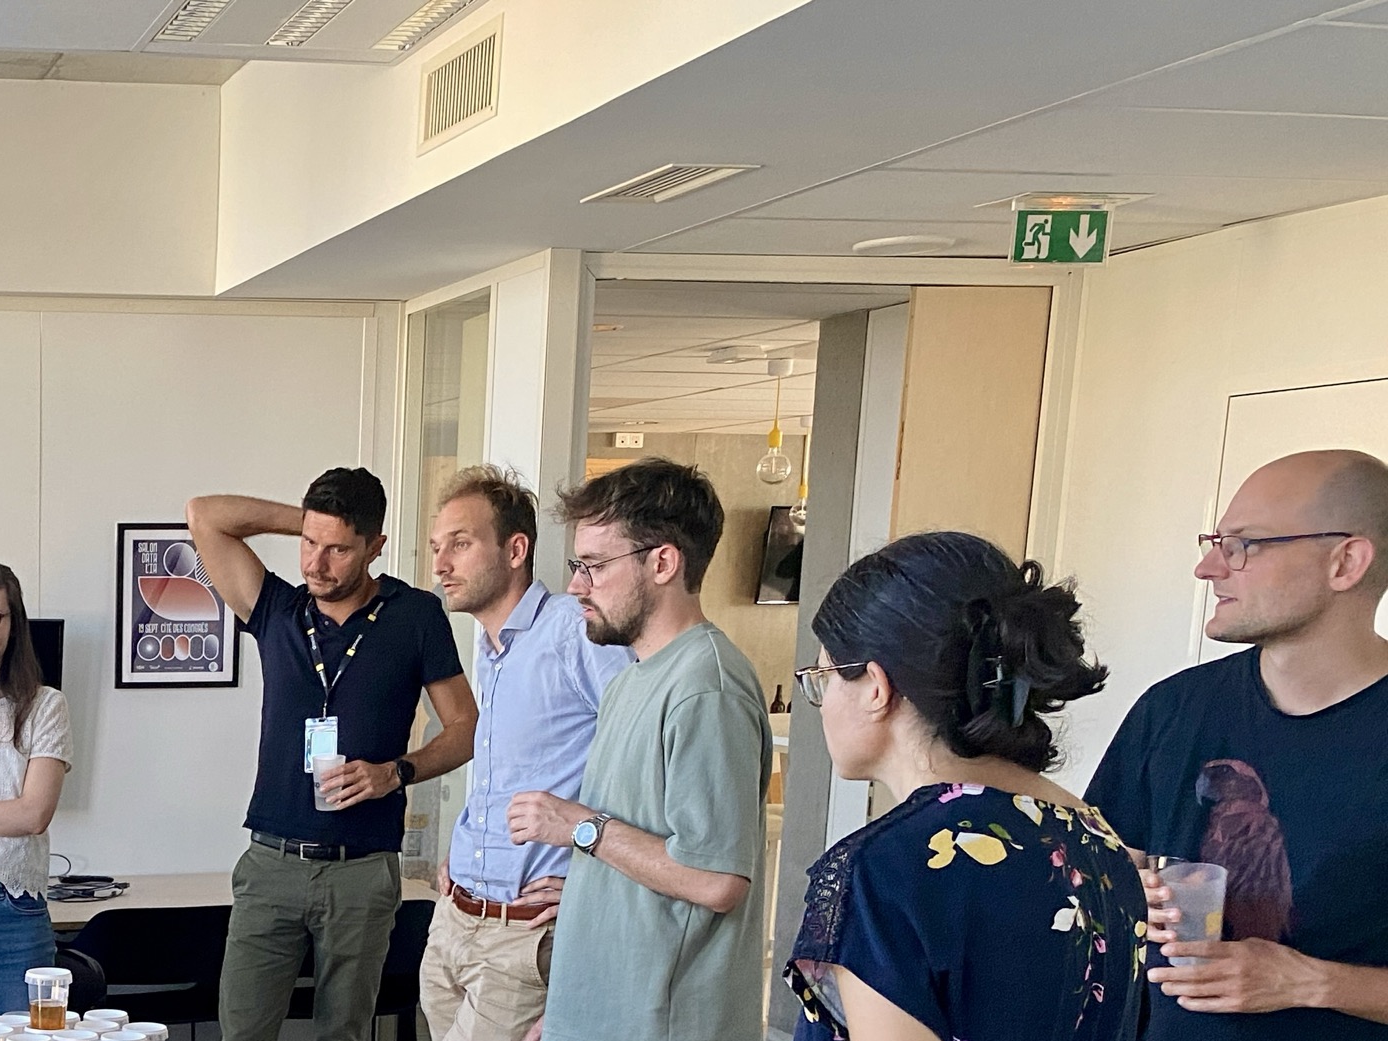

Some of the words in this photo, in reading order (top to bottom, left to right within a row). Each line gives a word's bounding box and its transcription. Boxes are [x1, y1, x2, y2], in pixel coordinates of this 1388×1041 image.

[138, 542, 158, 553] SALON
[141, 553, 158, 563] DATA
[145, 623, 158, 634] SEPT
[173, 623, 183, 634] DES
